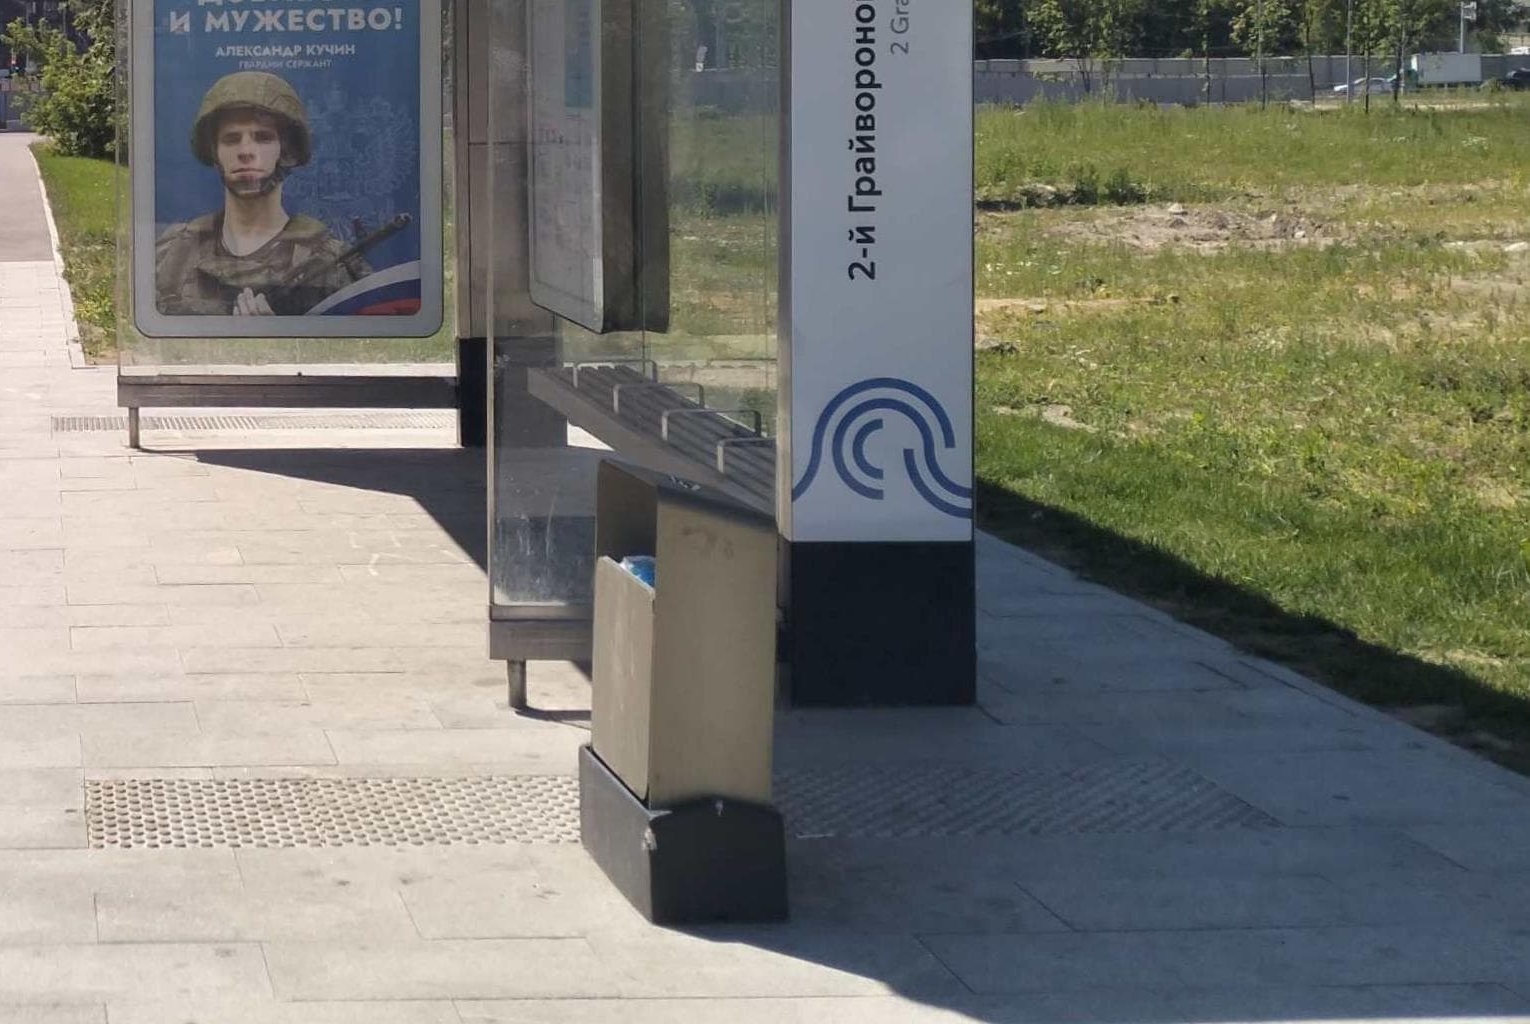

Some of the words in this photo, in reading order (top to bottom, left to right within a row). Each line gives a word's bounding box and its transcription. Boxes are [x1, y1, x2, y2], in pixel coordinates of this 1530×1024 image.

[170, 10, 191, 33] И
[204, 7, 402, 33] МУЖЕСТВО!
[215, 44, 303, 58] АЛЕКСАНДР
[305, 43, 356, 56] КУЧИН
[890, 41, 909, 55] 2
[285, 59, 334, 69] СЕРЖАНТ
[848, 227, 876, 281] 2-й
